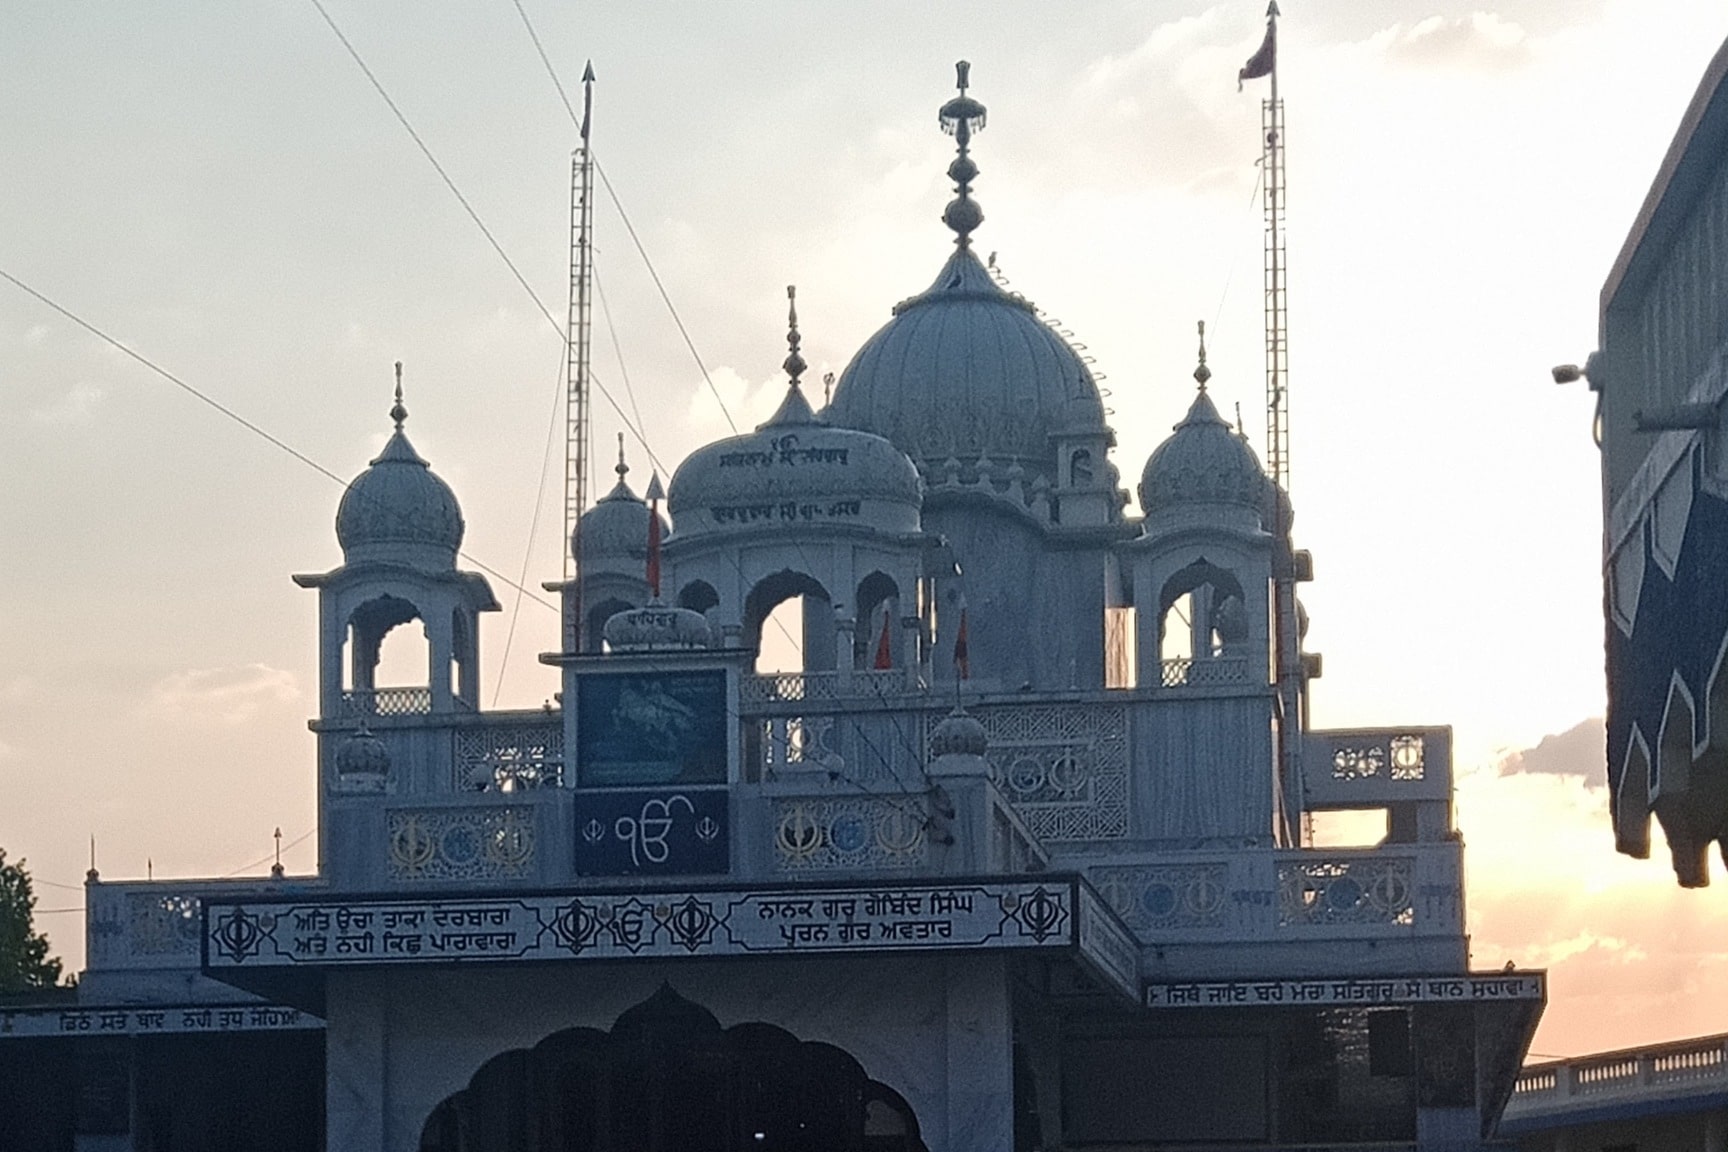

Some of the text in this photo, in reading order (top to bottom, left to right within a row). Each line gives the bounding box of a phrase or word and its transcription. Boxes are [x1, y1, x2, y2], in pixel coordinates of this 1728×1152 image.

[615, 795, 694, 867] ੴ
[758, 900, 814, 919] ਨਾਨਕ
[864, 892, 922, 915] ਗੋਬਿੰਦ
[930, 892, 973, 915] ਸਿੰਘ
[294, 909, 330, 931] ਅਤਿ
[432, 908, 510, 928] ਦਰਬਾਰਾ
[879, 920, 952, 940] ਅਵਤਾਰ
[429, 932, 517, 952] ਪਾਰਾਵਾਰਾ
